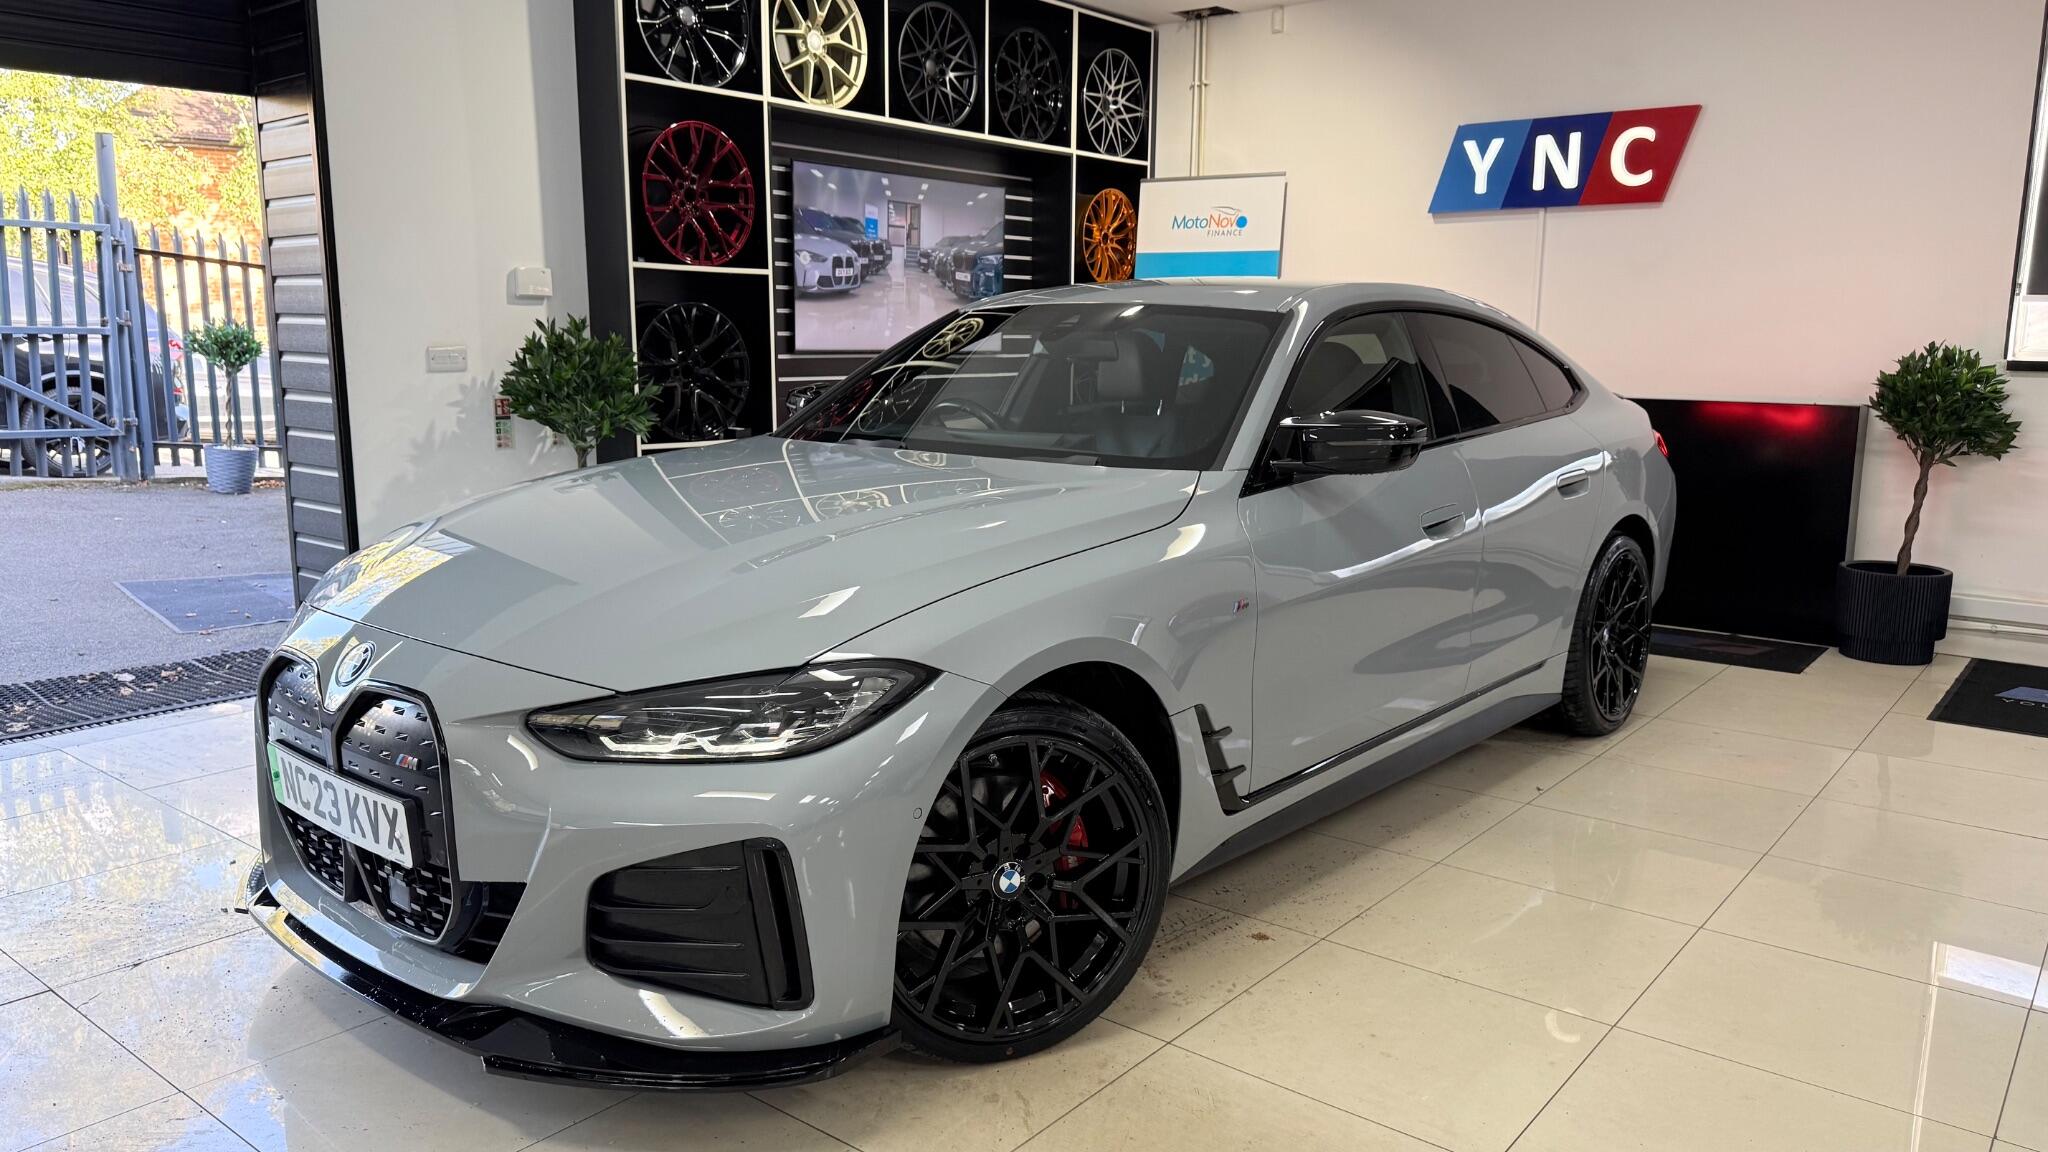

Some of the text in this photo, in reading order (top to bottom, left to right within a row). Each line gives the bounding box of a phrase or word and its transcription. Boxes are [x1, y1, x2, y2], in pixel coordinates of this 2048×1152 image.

[1463, 126, 1656, 194] YNC
[1207, 230, 1242, 238] FINANCE
[281, 757, 405, 855] NC23 KVX
[1003, 863, 1026, 883] BMW
